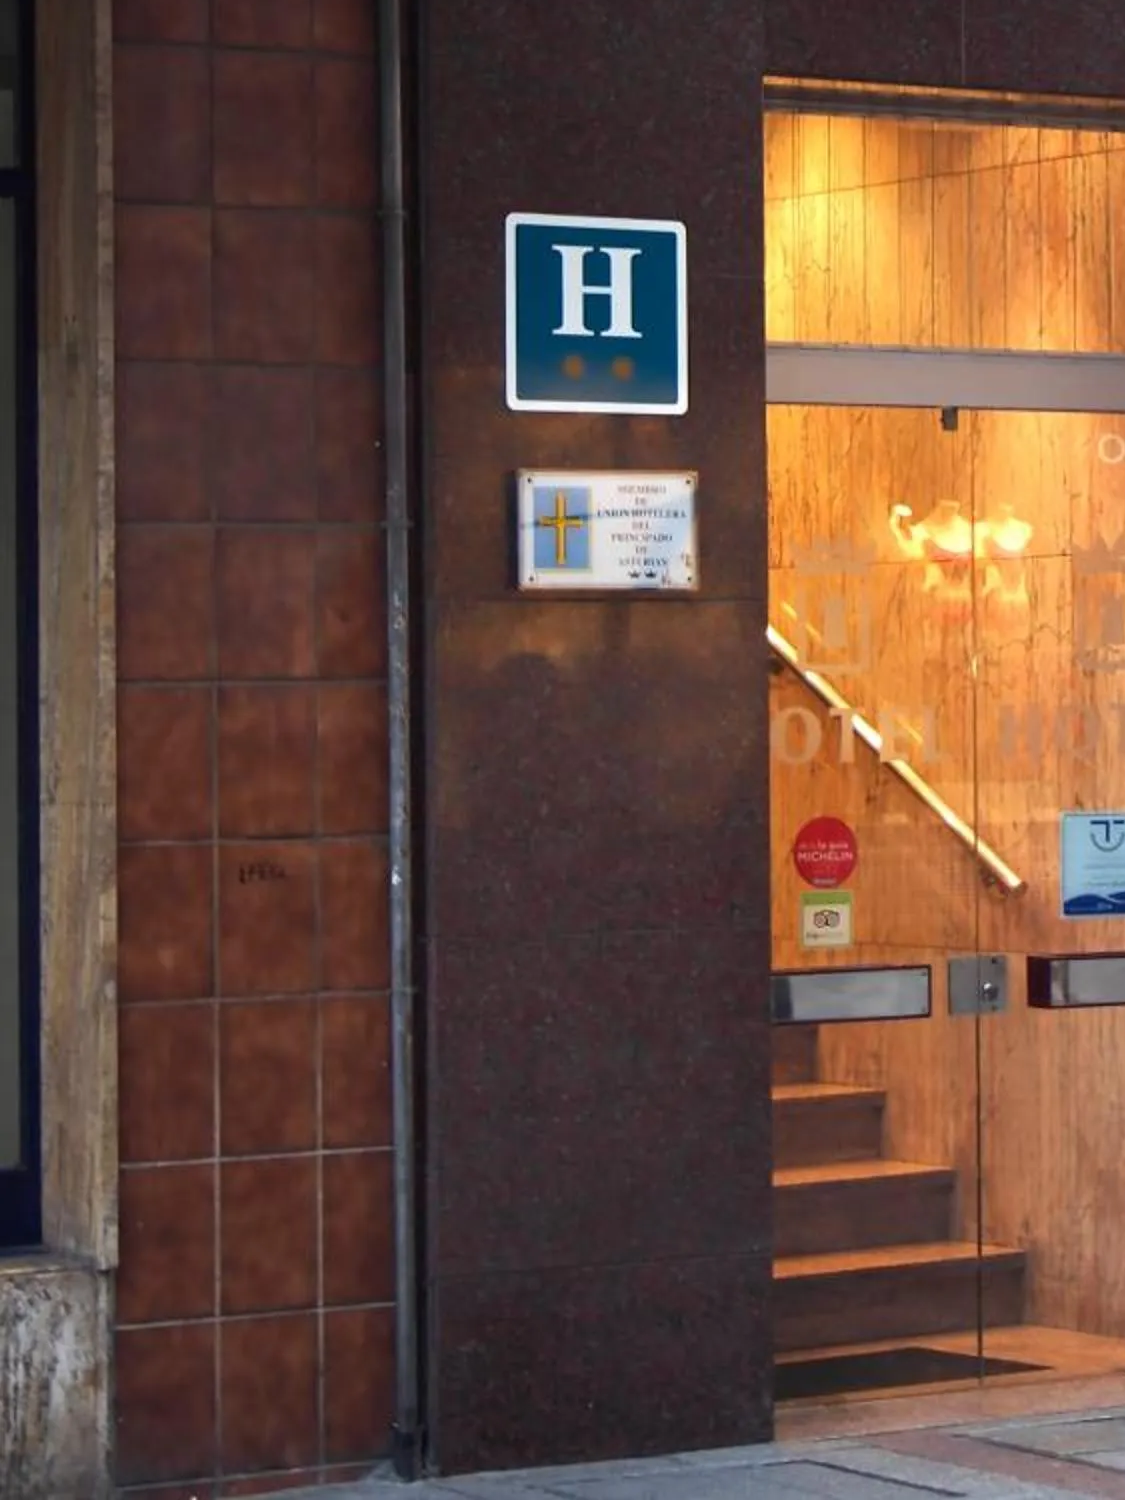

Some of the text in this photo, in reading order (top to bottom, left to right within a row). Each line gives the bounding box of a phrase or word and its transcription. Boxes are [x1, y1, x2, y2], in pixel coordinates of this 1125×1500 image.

[552, 244, 643, 339] H
[768, 705, 952, 769] OTEL
[797, 851, 854, 863] MICHELIN
